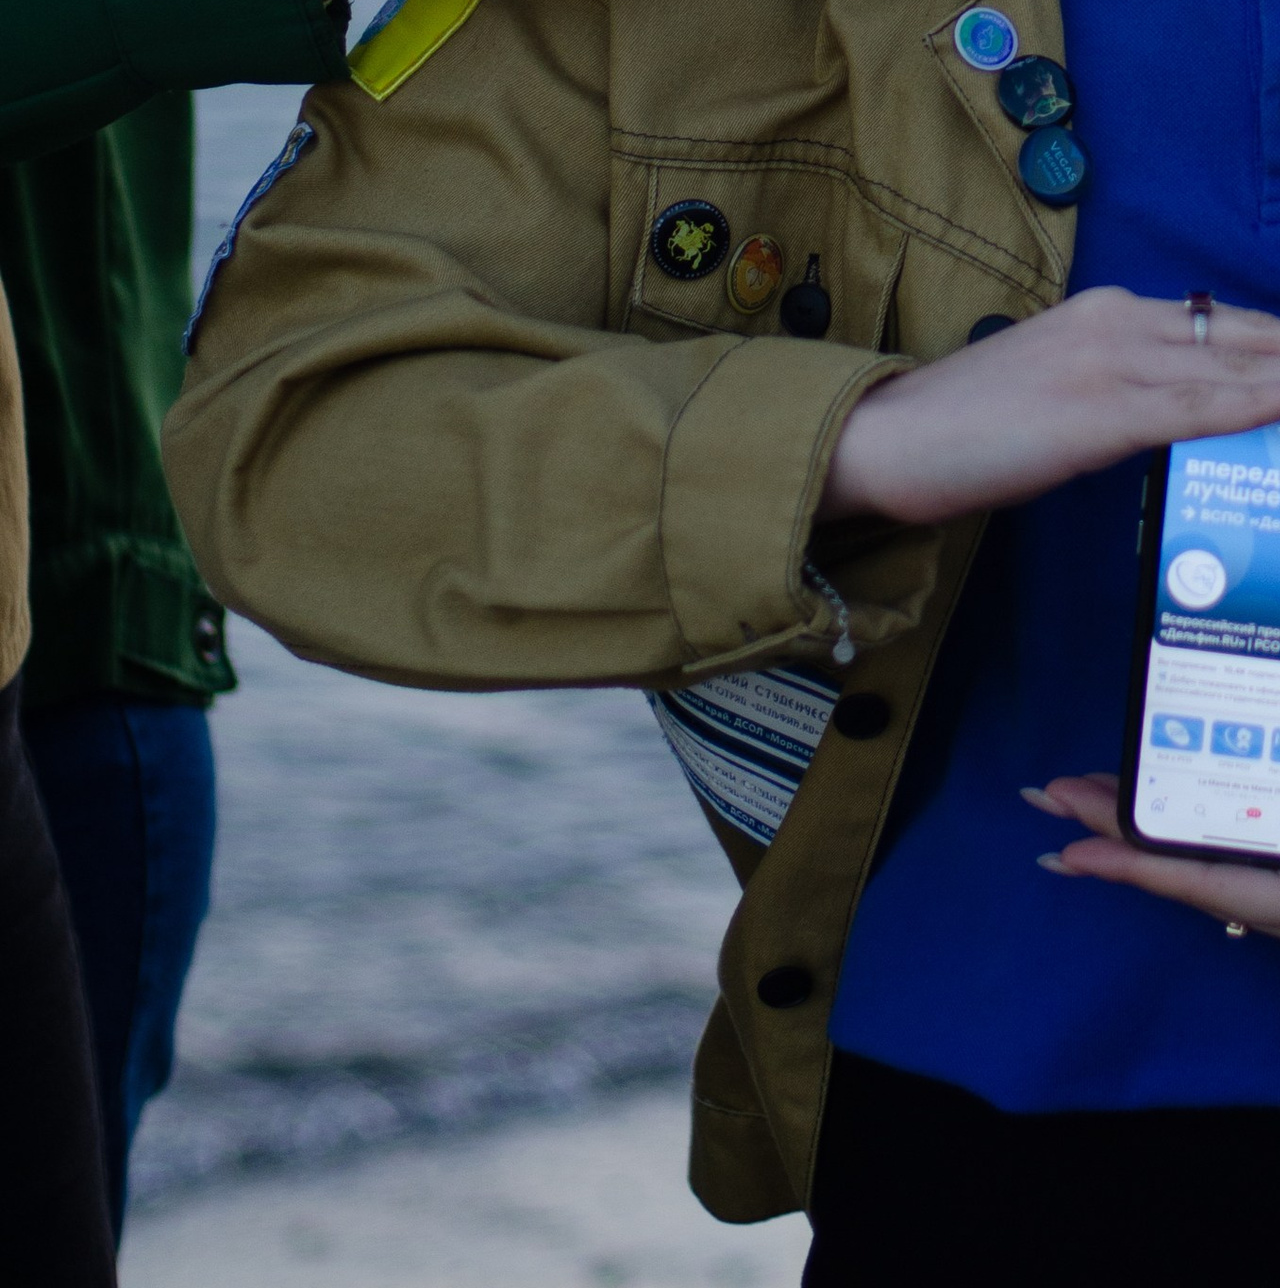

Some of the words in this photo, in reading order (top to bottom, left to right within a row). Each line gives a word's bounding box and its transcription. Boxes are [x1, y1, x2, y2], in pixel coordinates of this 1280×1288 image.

[1050, 141, 1077, 182] VEGAS
[1200, 508, 1245, 525] ВСПО
[1160, 611, 1256, 635] Всероссийский
[719, 674, 749, 690] КИЙ
